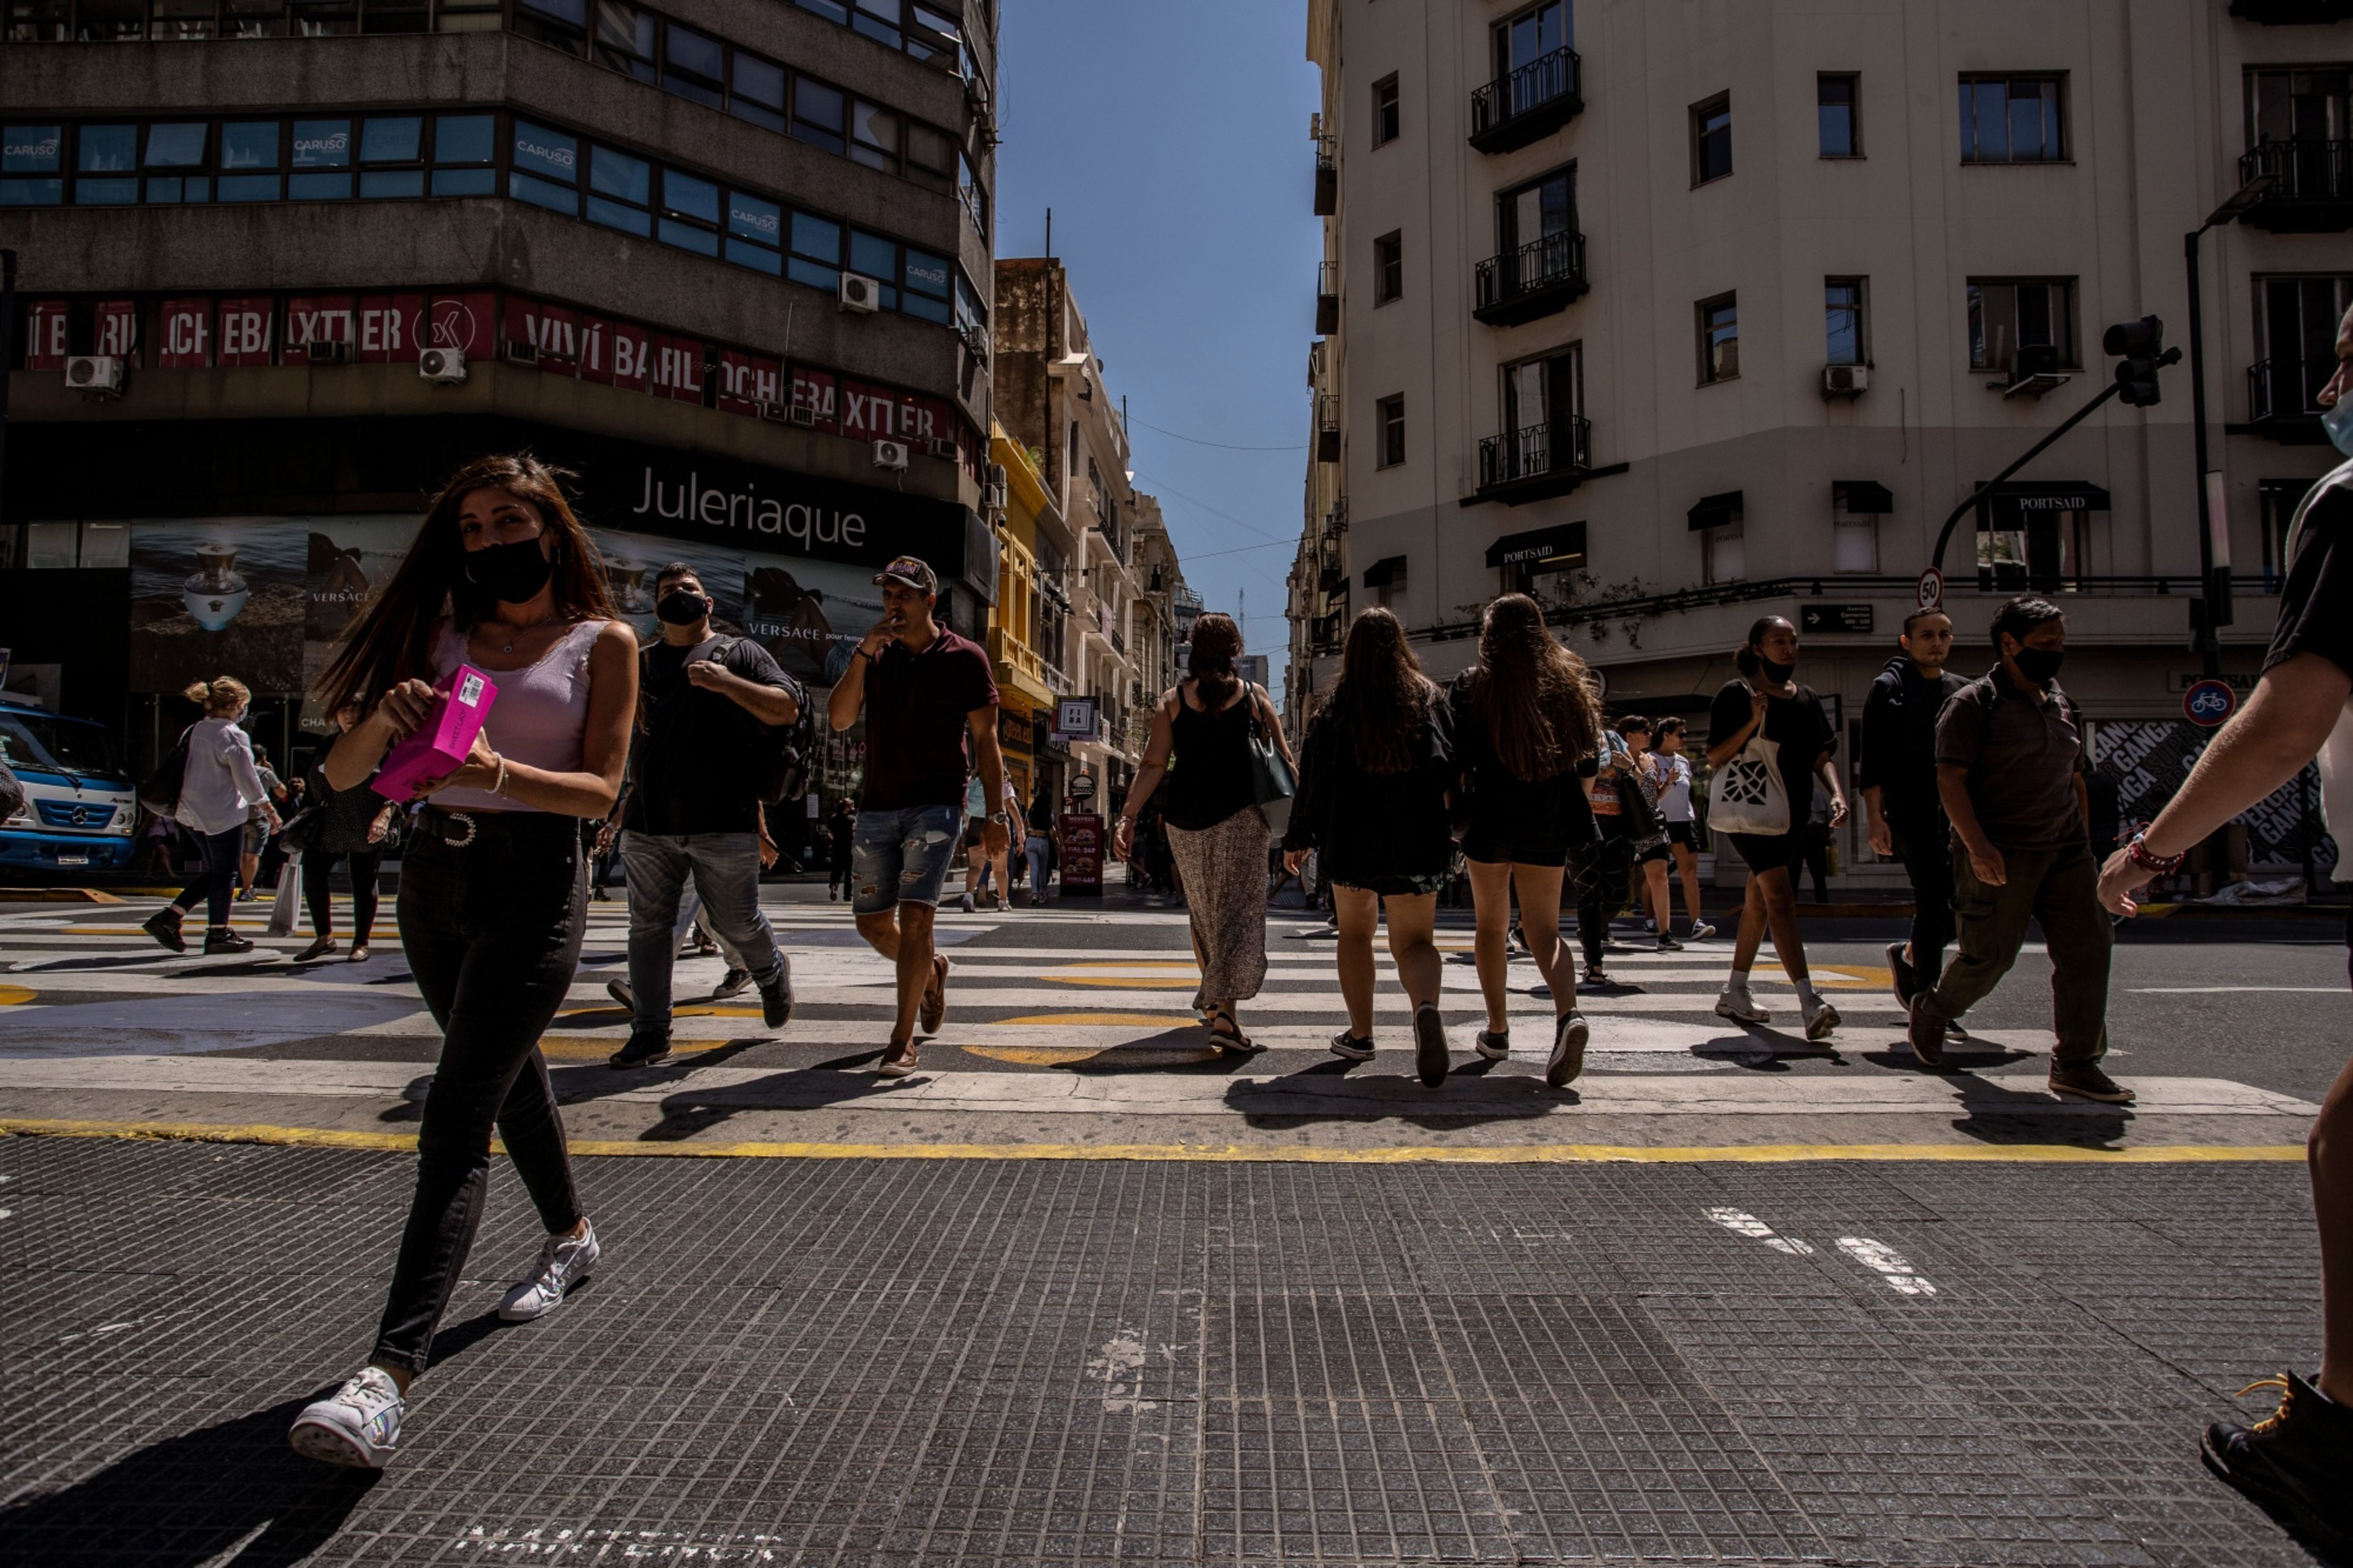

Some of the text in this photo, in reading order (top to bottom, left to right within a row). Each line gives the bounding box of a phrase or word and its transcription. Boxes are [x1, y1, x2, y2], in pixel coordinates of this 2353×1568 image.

[4, 145, 56, 156] CARUSO
[294, 139, 346, 150] CARUSO
[517, 141, 573, 166] CARUSO
[731, 209, 776, 230] CARUSO
[907, 265, 945, 283] CARUSO
[633, 467, 866, 551] Juleriaque
[2019, 497, 2086, 510] PORTSAID
[1504, 545, 1553, 564] PORTSAID
[313, 592, 371, 602] VERSACE
[1922, 580, 1937, 600] 50
[749, 623, 865, 642] VERSACE pour femm
